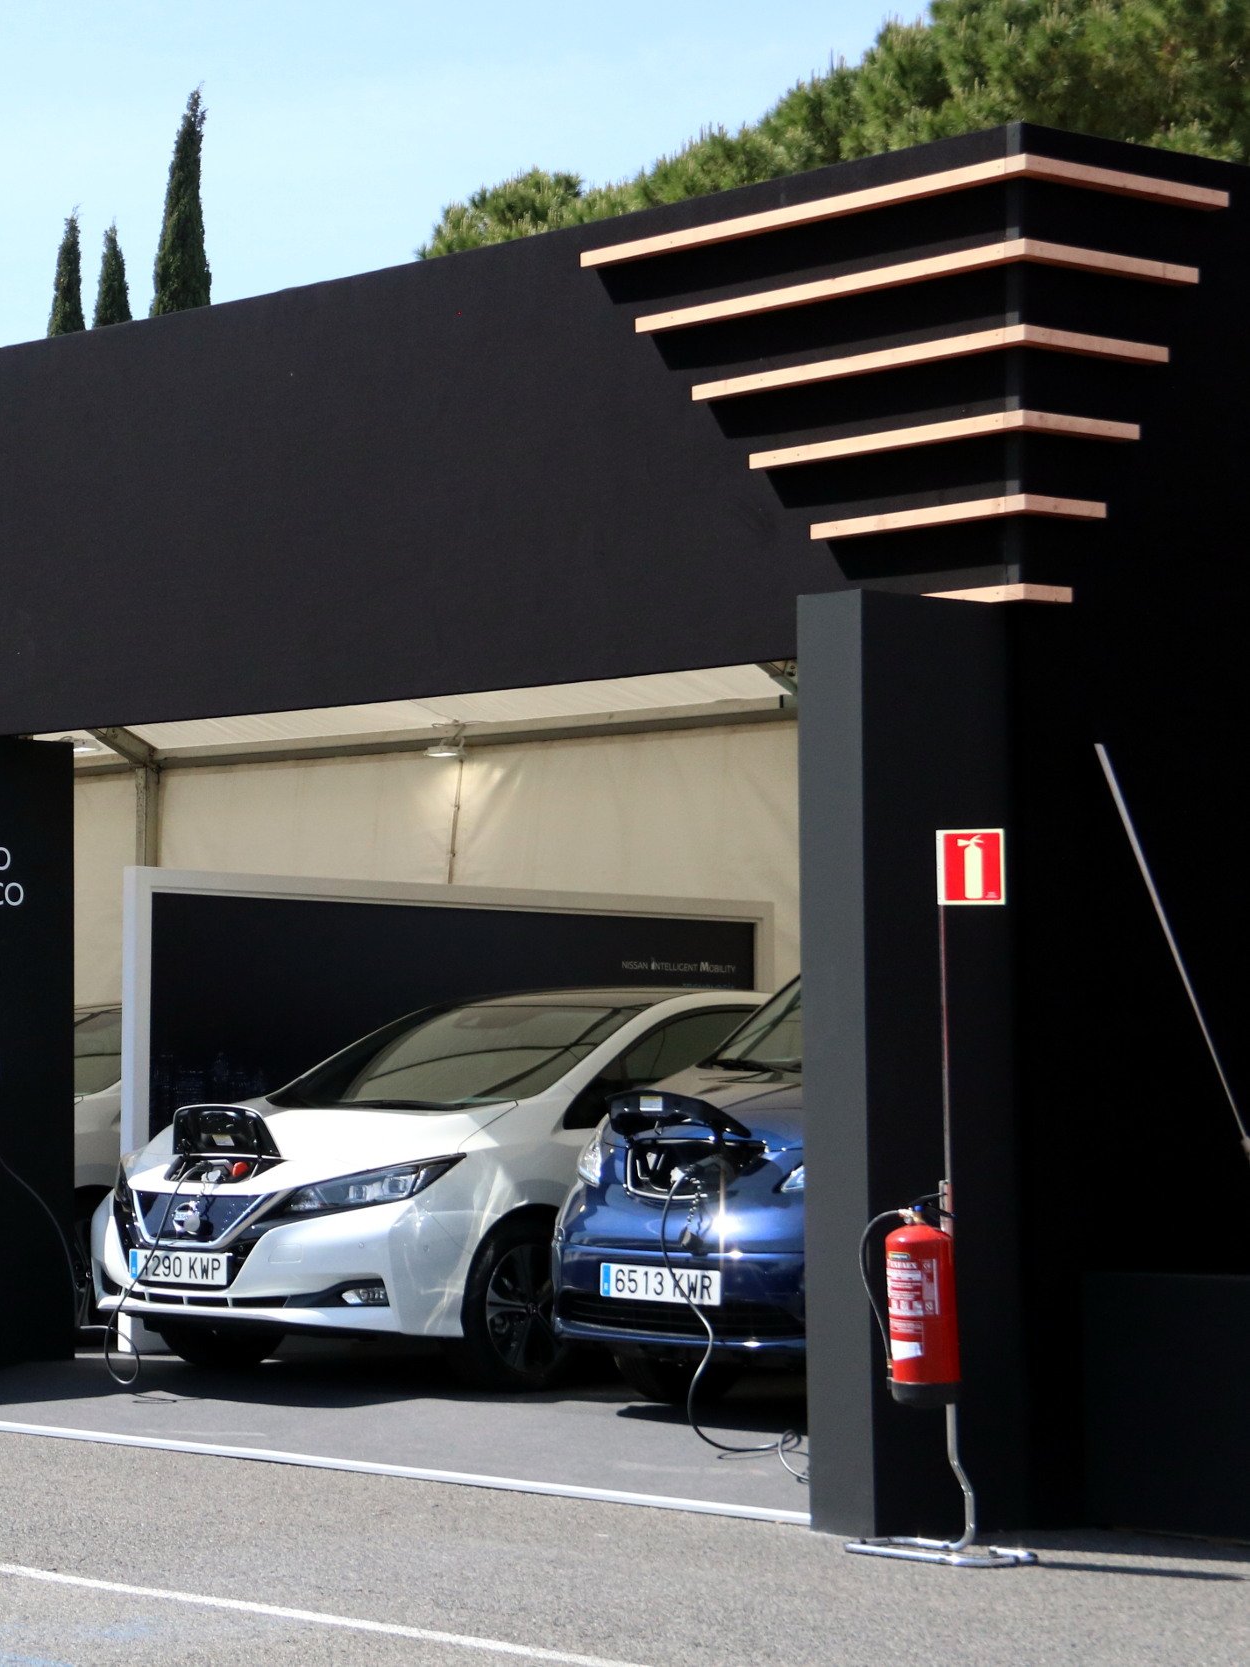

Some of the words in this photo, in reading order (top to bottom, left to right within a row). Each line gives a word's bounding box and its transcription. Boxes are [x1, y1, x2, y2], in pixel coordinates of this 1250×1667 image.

[621, 961, 649, 970] NISSAN
[699, 962, 736, 973] MOBILITY
[189, 1257, 221, 1280] KWP
[615, 1268, 664, 1296] 6513
[670, 1272, 712, 1300] KWR
